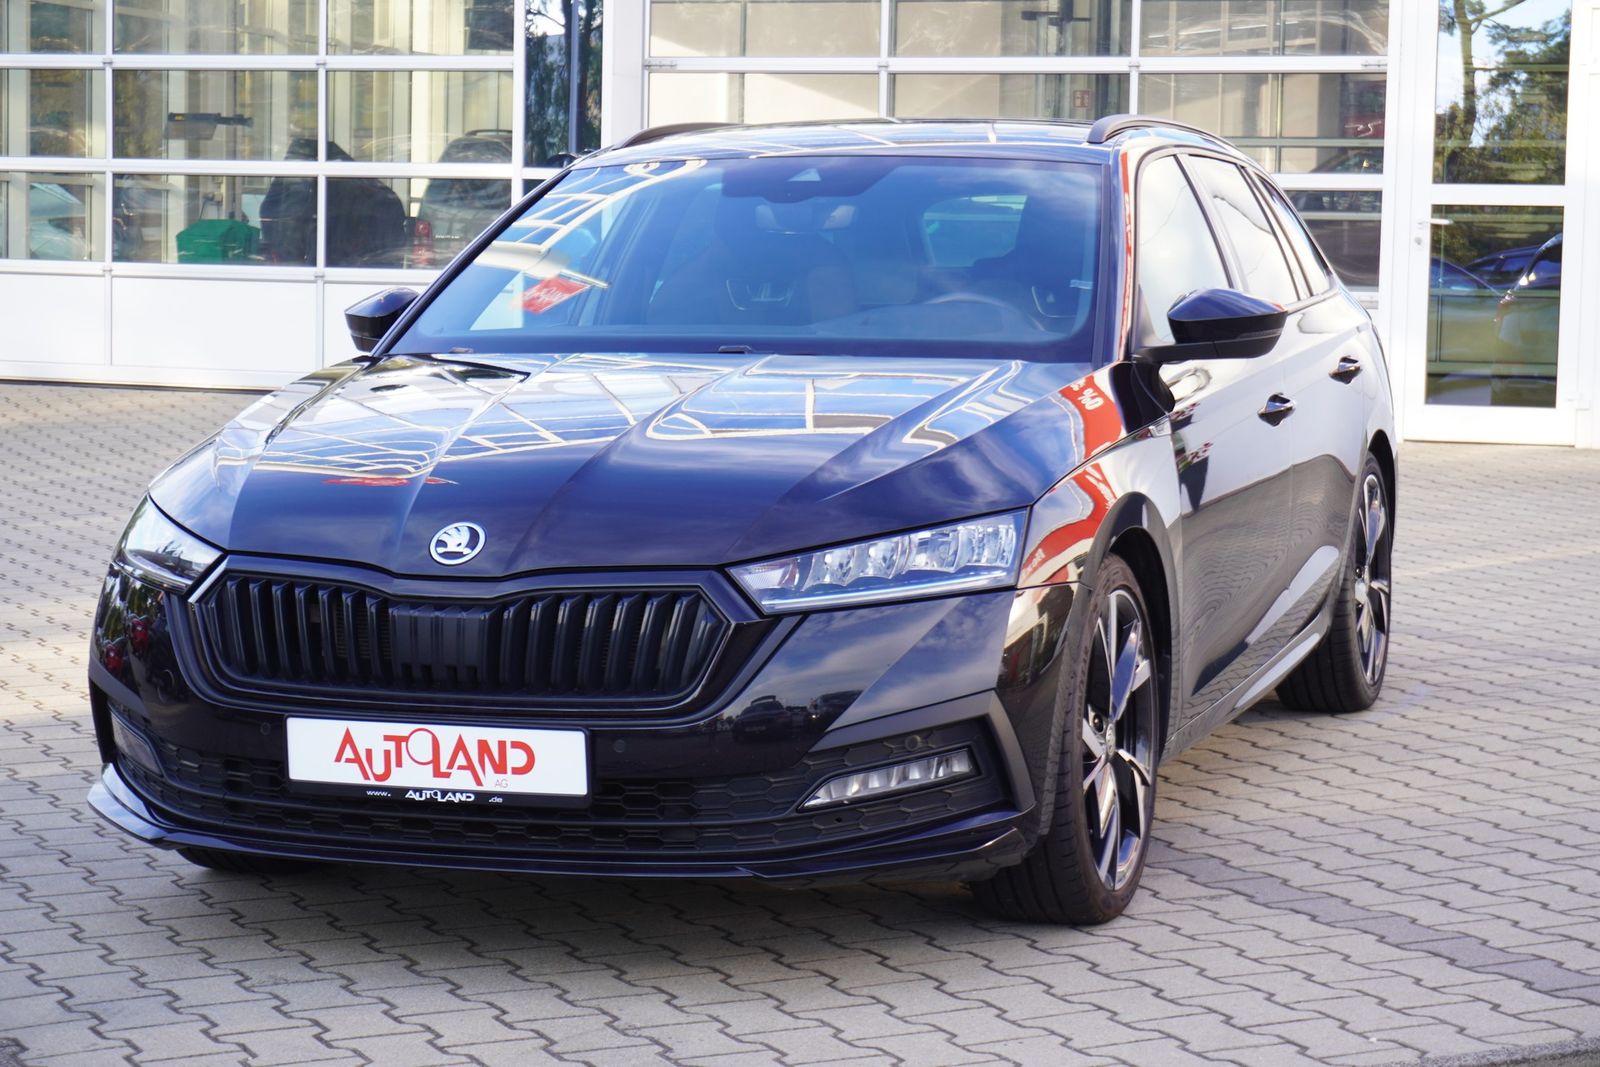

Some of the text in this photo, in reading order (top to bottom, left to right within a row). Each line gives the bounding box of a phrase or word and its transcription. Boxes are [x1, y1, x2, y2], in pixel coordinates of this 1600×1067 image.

[334, 726, 536, 787] AUTOLAND
[494, 778, 509, 789] AG
[366, 789, 391, 797] www.
[405, 789, 475, 803] AUTOLAND
